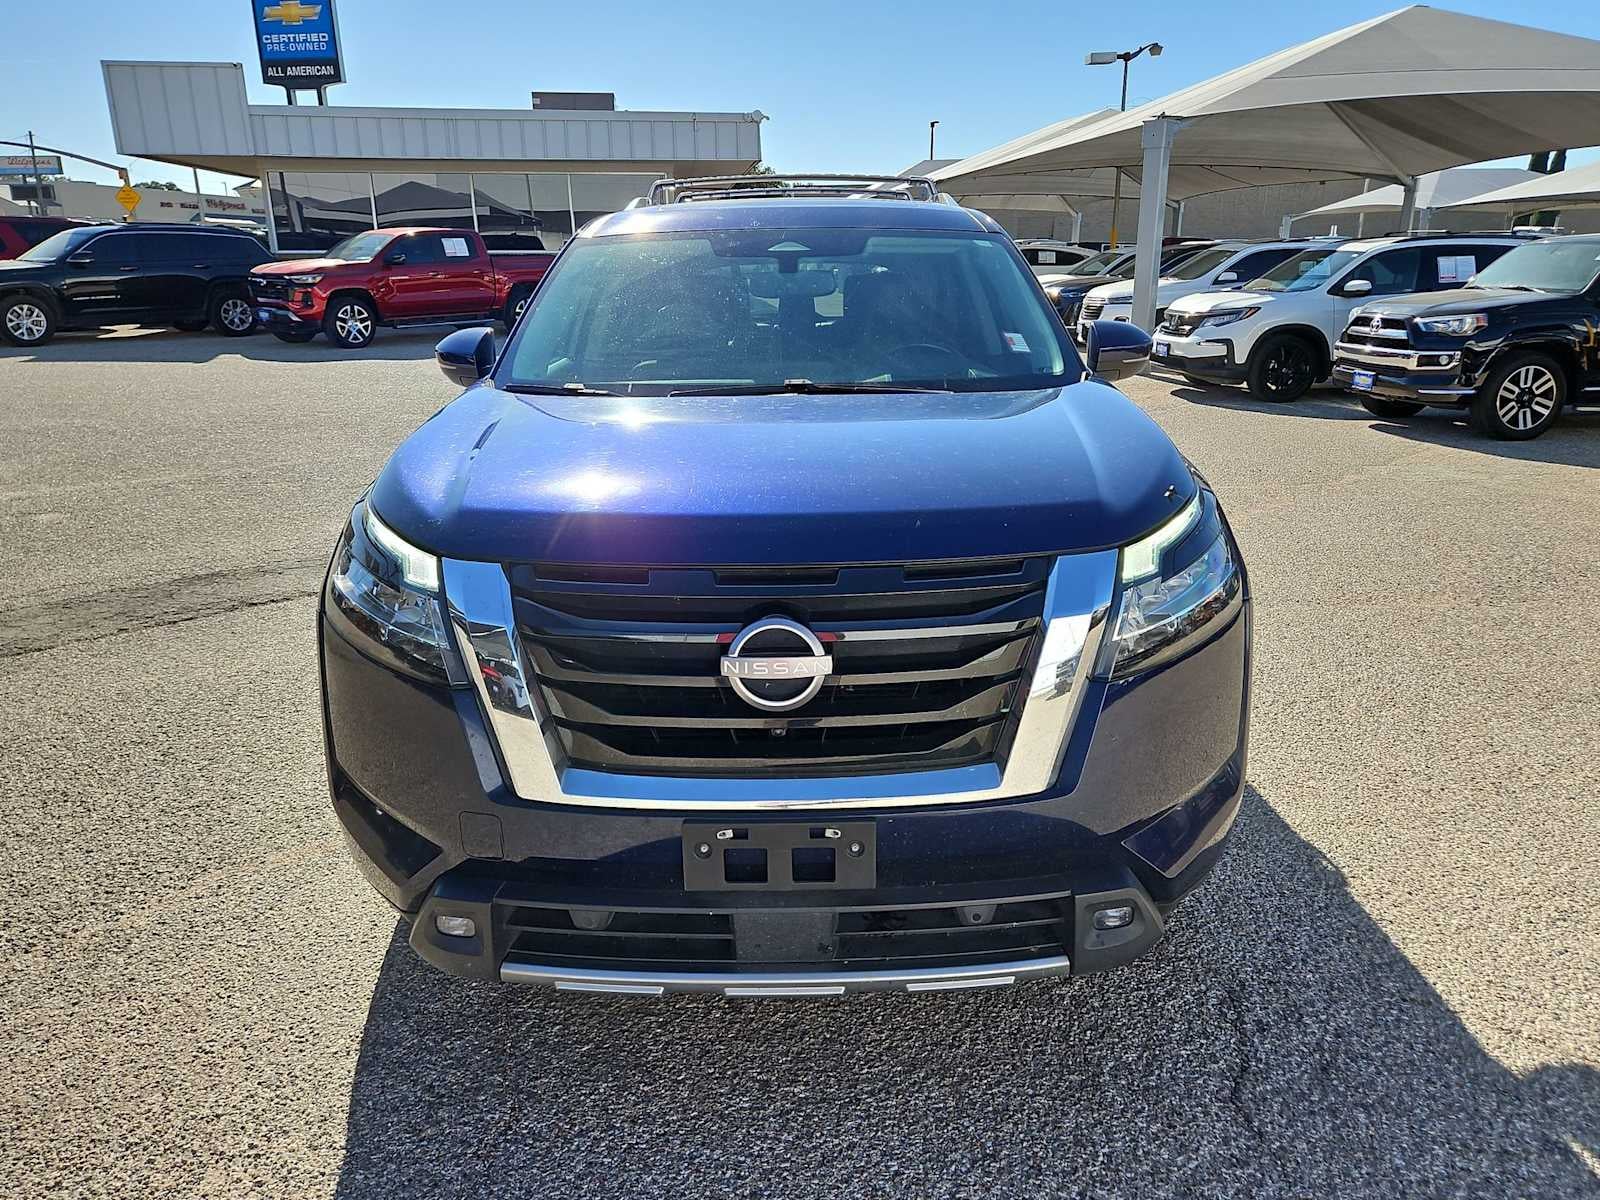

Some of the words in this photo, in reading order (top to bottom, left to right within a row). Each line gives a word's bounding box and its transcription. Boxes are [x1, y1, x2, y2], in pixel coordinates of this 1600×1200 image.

[262, 32, 329, 43] CERTIFIED
[266, 42, 327, 52] PRE-OWNED
[267, 66, 285, 76] ALL
[286, 65, 334, 76] AMERICAN
[723, 660, 830, 675] NISSAN
